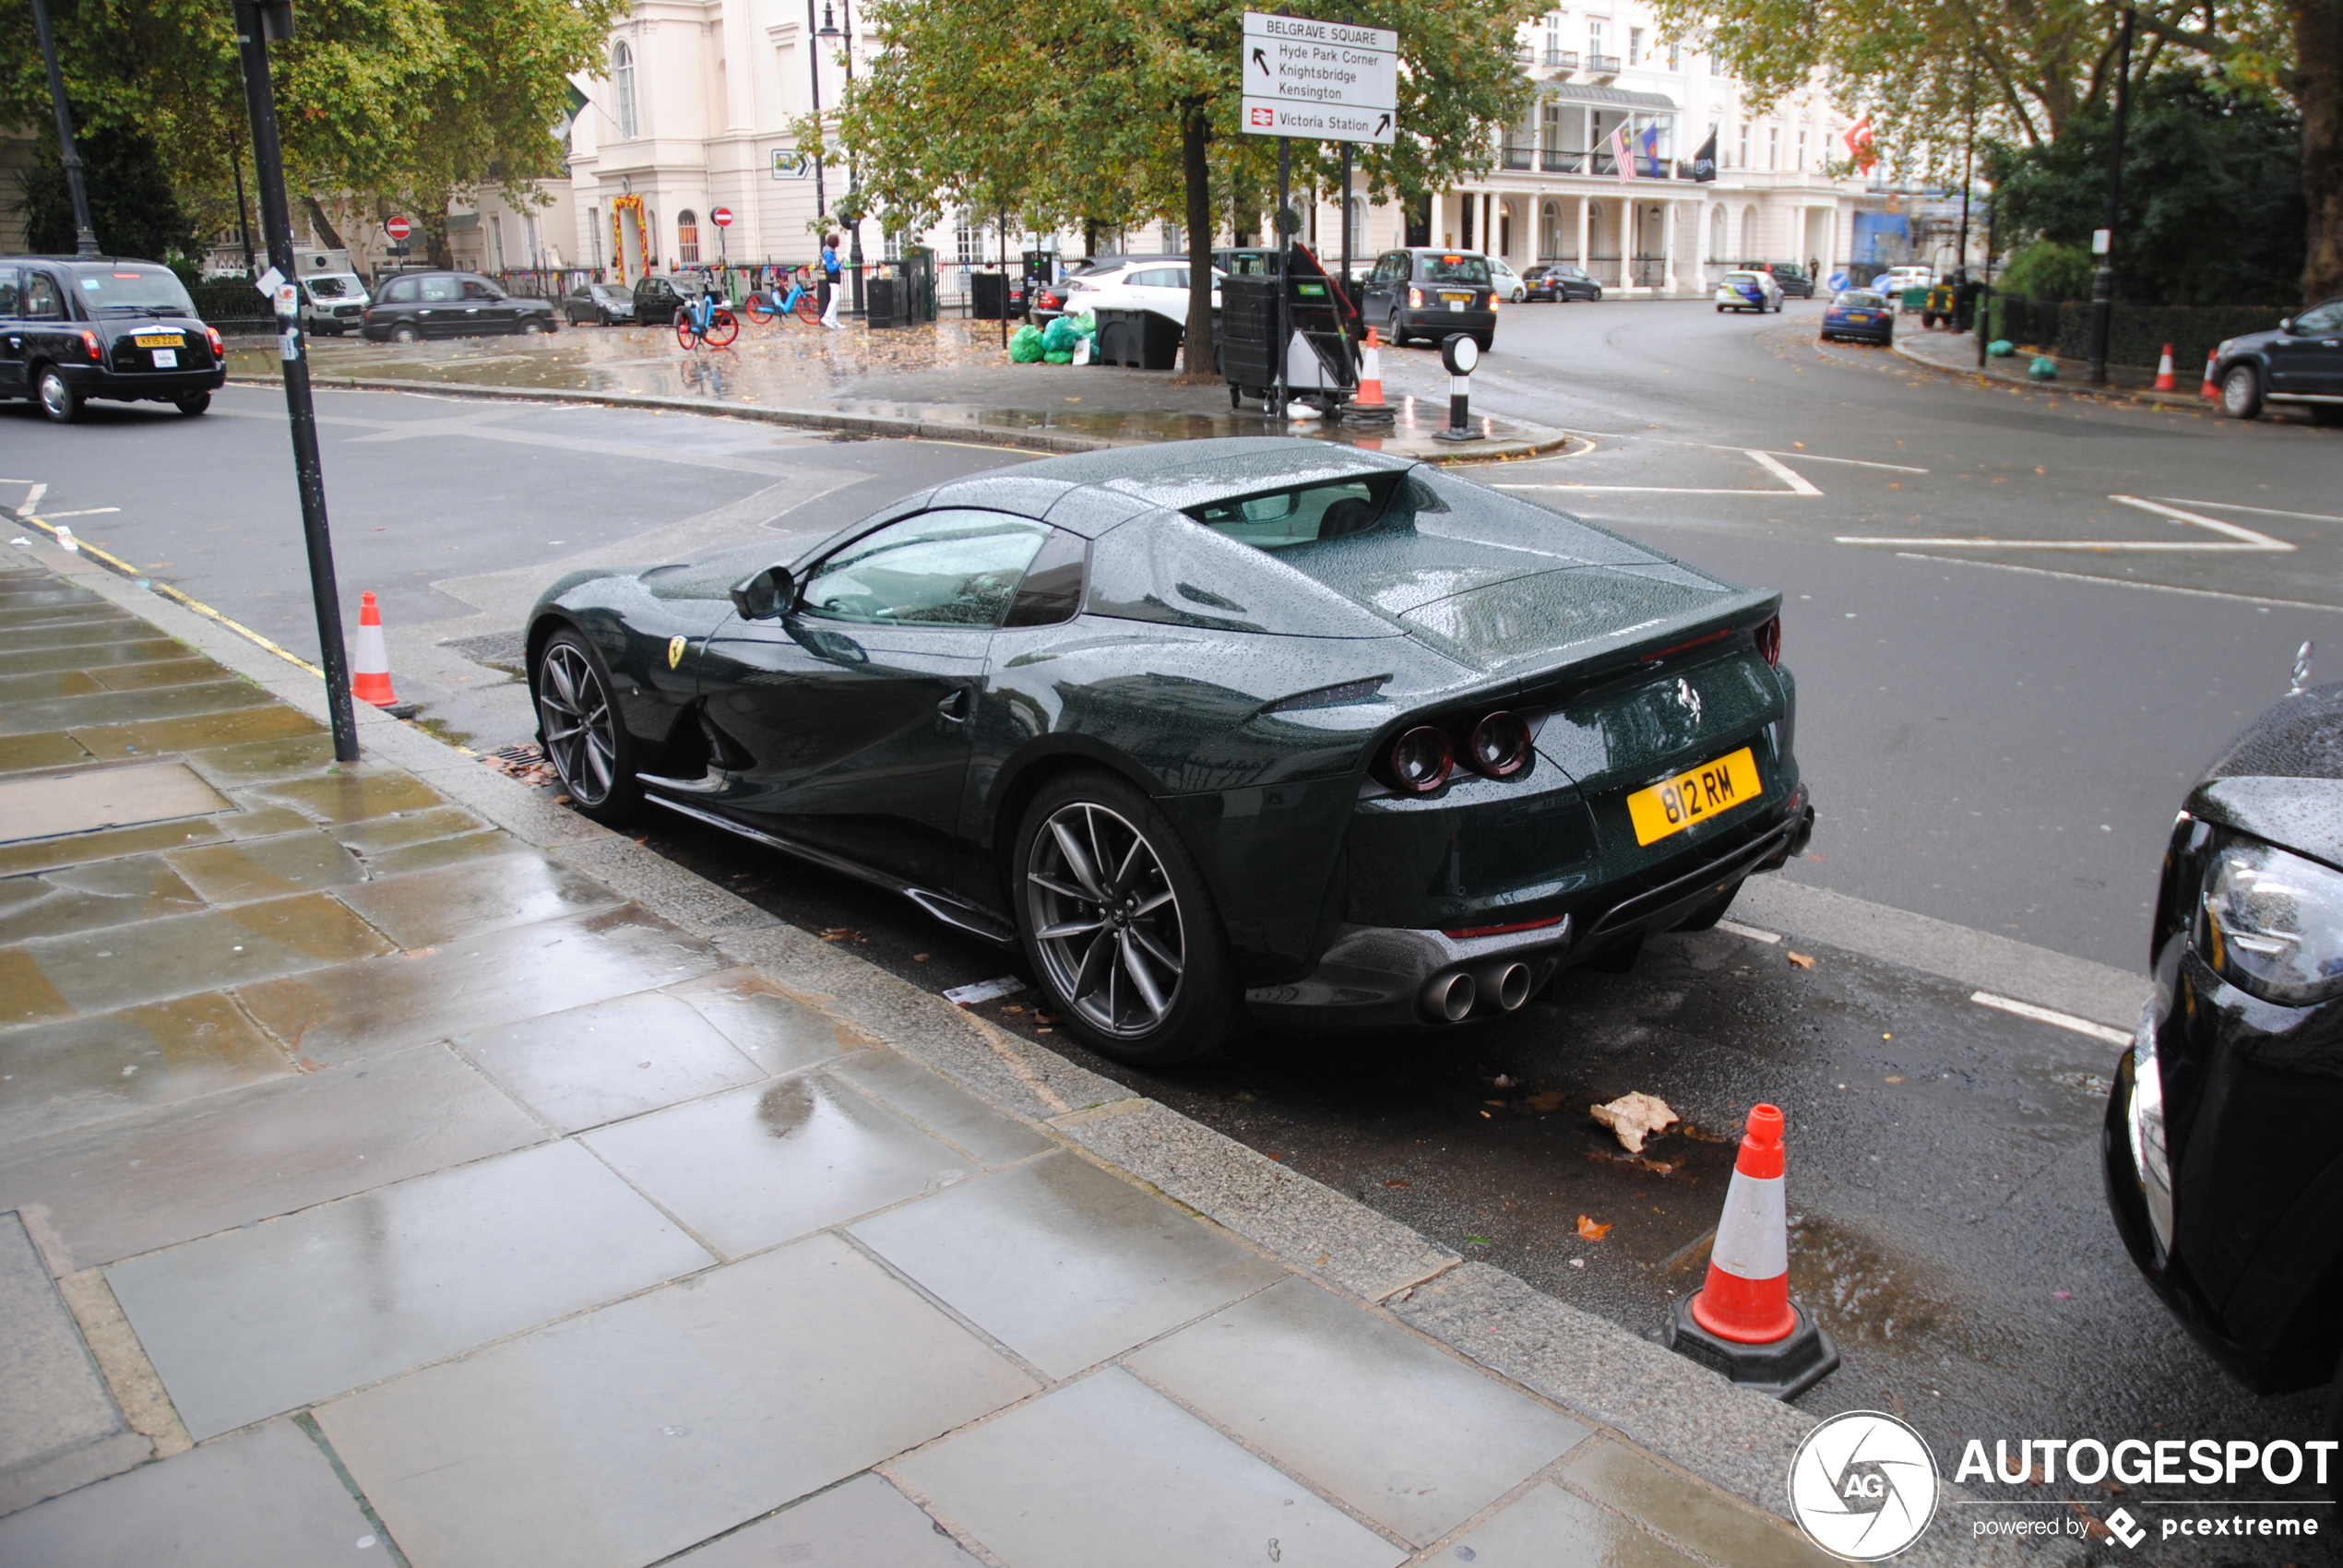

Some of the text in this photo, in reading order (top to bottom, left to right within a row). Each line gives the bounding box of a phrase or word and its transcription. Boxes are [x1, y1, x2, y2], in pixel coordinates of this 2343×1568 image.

[1267, 20, 1376, 45] BELGRAVE SQUARE
[1279, 43, 1378, 65] Hyde Park Corner
[1279, 63, 1357, 84] Knightsbridge
[1279, 82, 1342, 100] Kensington
[1279, 113, 1369, 131] Victoria Station
[1661, 765, 1735, 825] 812 RM
